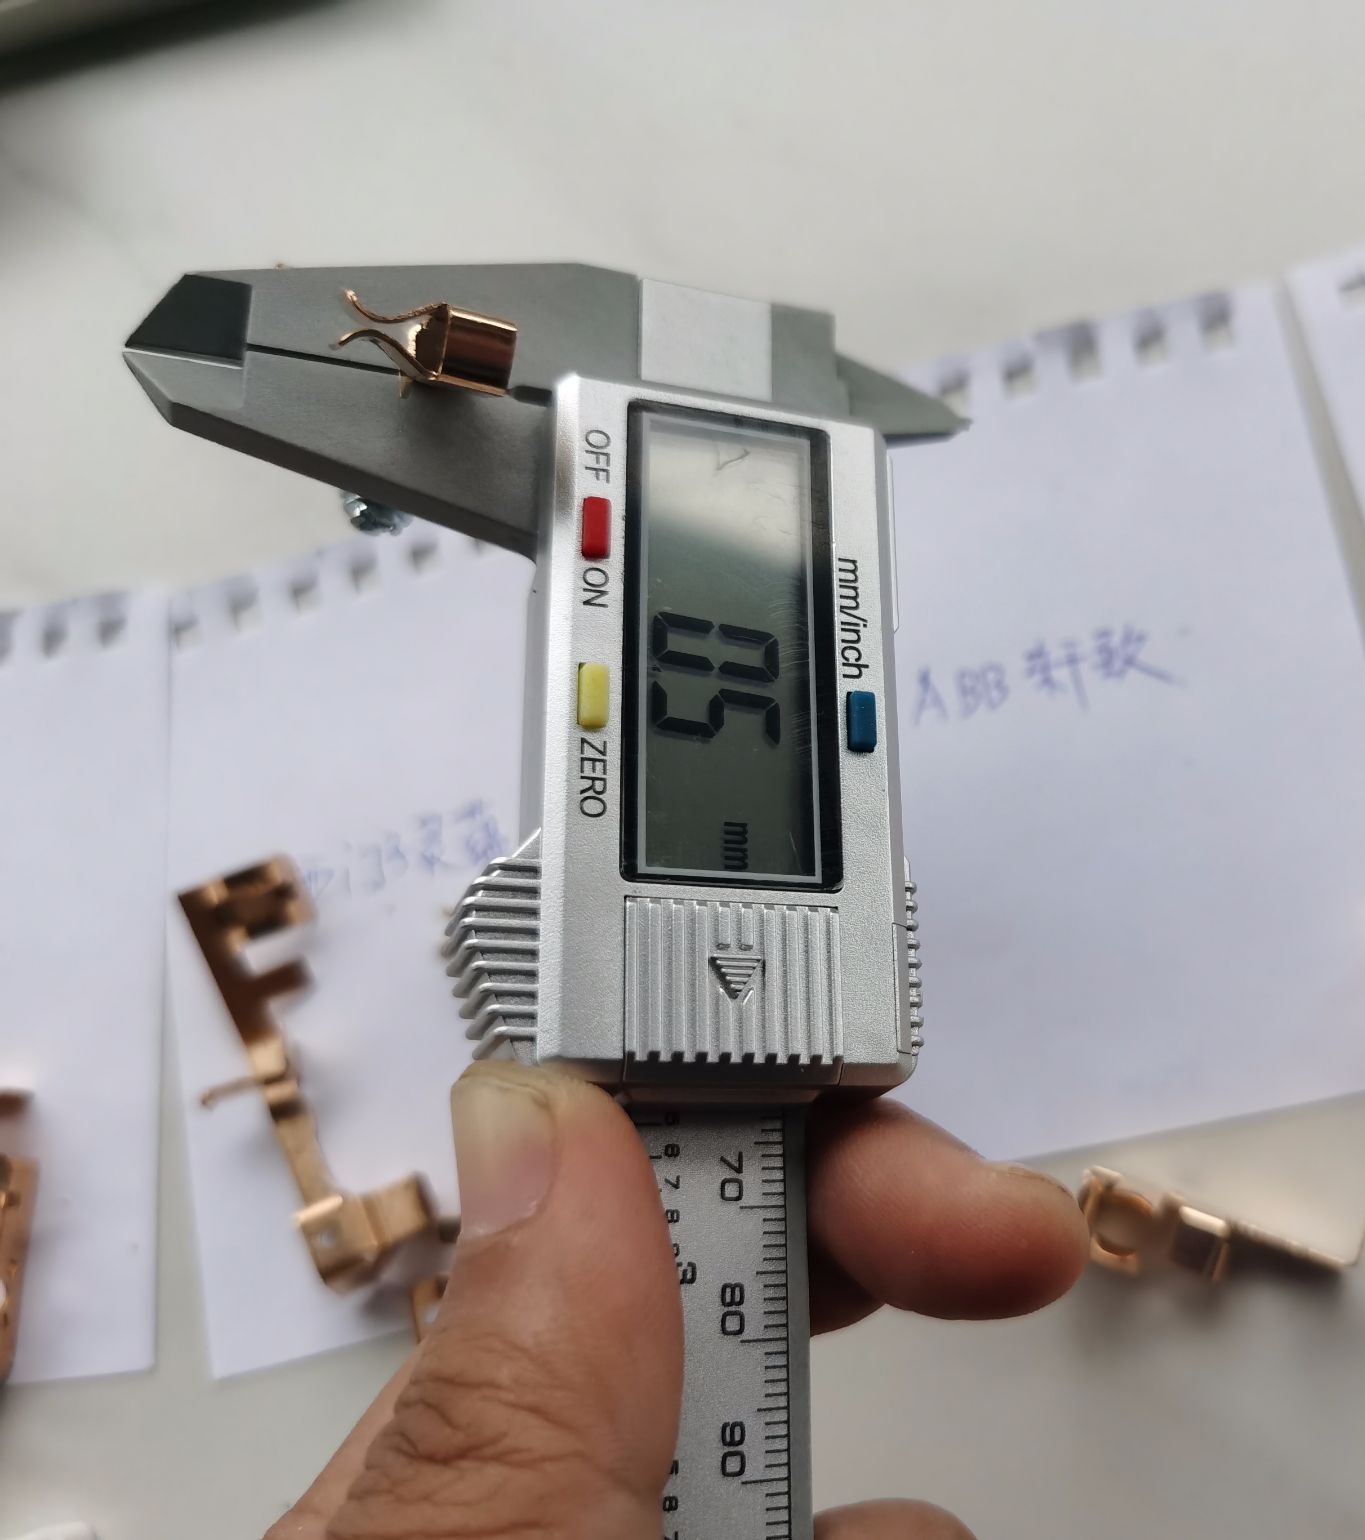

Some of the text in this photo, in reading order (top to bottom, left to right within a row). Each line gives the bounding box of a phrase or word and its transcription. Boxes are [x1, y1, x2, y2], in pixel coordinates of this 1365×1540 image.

[584, 428, 611, 484] OFF
[582, 566, 610, 609] ON
[838, 557, 870, 680] mm/inch
[578, 736, 608, 819] ZERO
[722, 821, 749, 870] mm
[664, 1175, 681, 1190] 7
[665, 1209, 680, 1224] 8
[719, 1151, 746, 1479] 70 80 90
